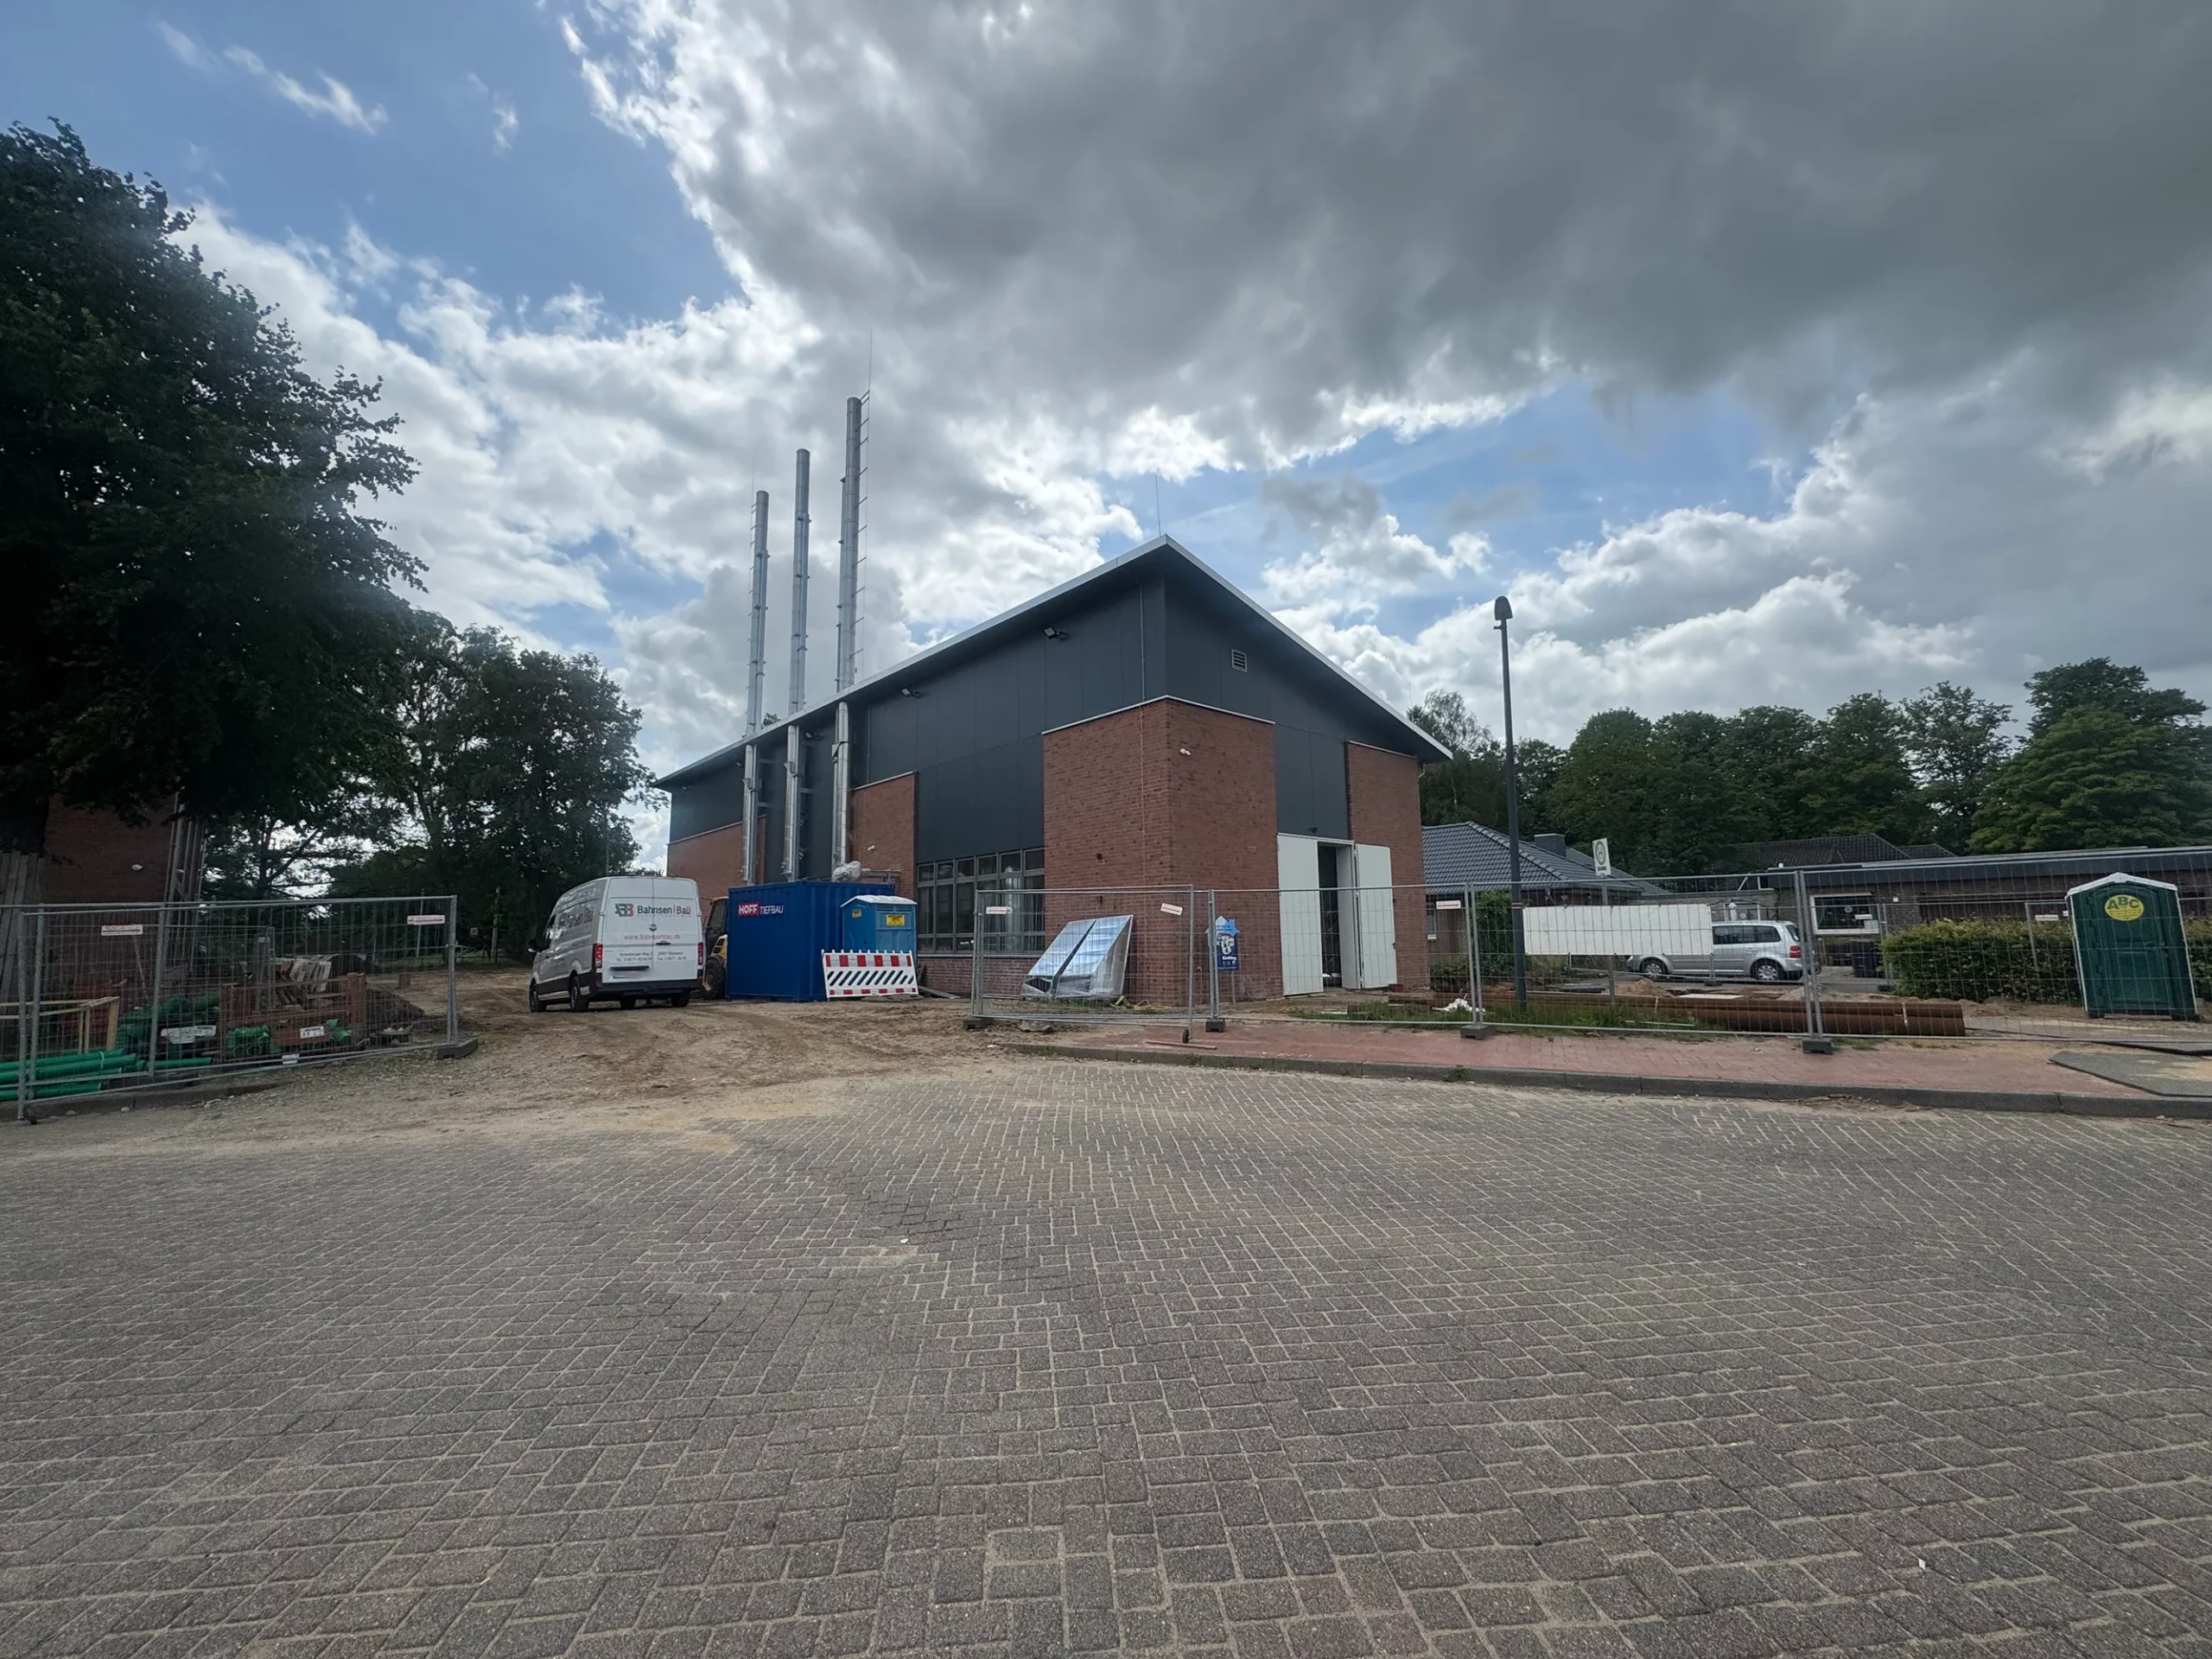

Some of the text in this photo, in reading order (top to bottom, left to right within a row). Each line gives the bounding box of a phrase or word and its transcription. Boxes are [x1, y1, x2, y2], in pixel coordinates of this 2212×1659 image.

[2107, 896, 2139, 909] ABC
[637, 905, 691, 914] Bahnsen Bau
[739, 904, 784, 914] HOFF TIEFBAU
